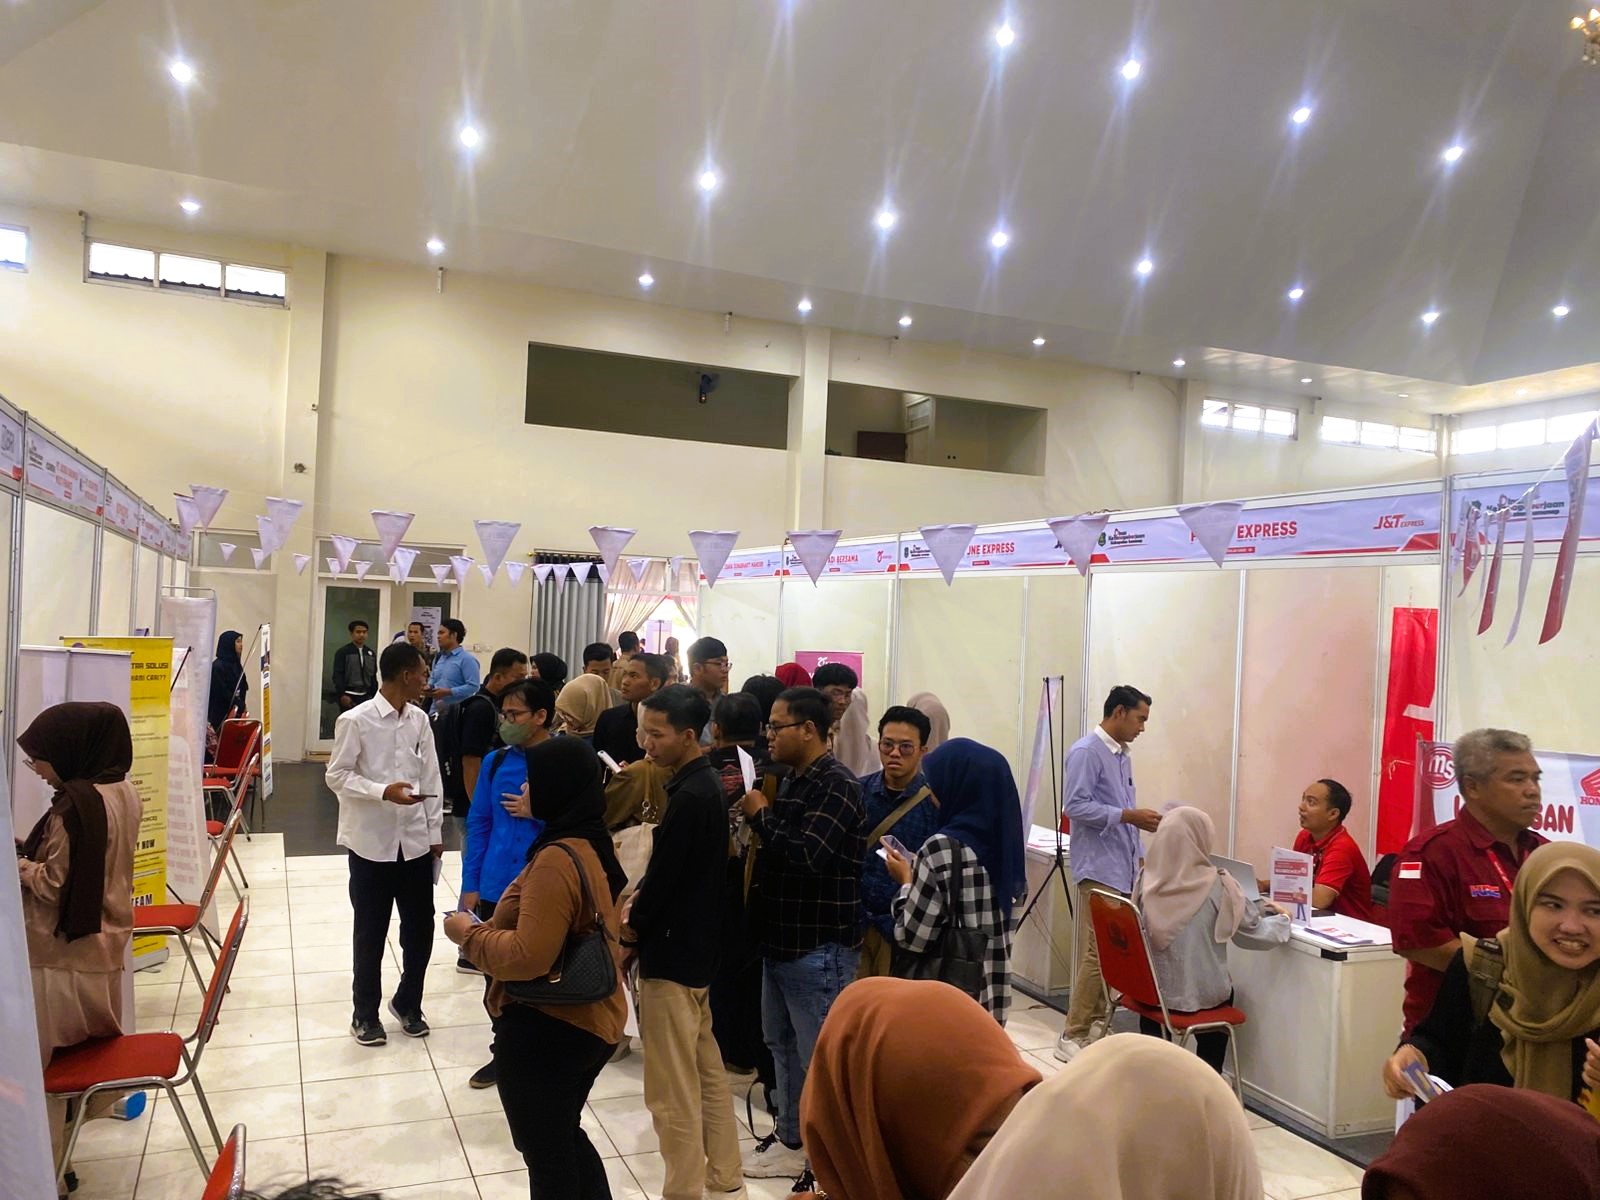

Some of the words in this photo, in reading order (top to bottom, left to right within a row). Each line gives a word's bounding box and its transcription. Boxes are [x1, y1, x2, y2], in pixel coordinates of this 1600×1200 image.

[1373, 514, 1406, 529] J&T
[1401, 519, 1425, 527] EXPRESS
[1237, 521, 1298, 539] EXPRESS
[982, 542, 1015, 554] EXPRESS
